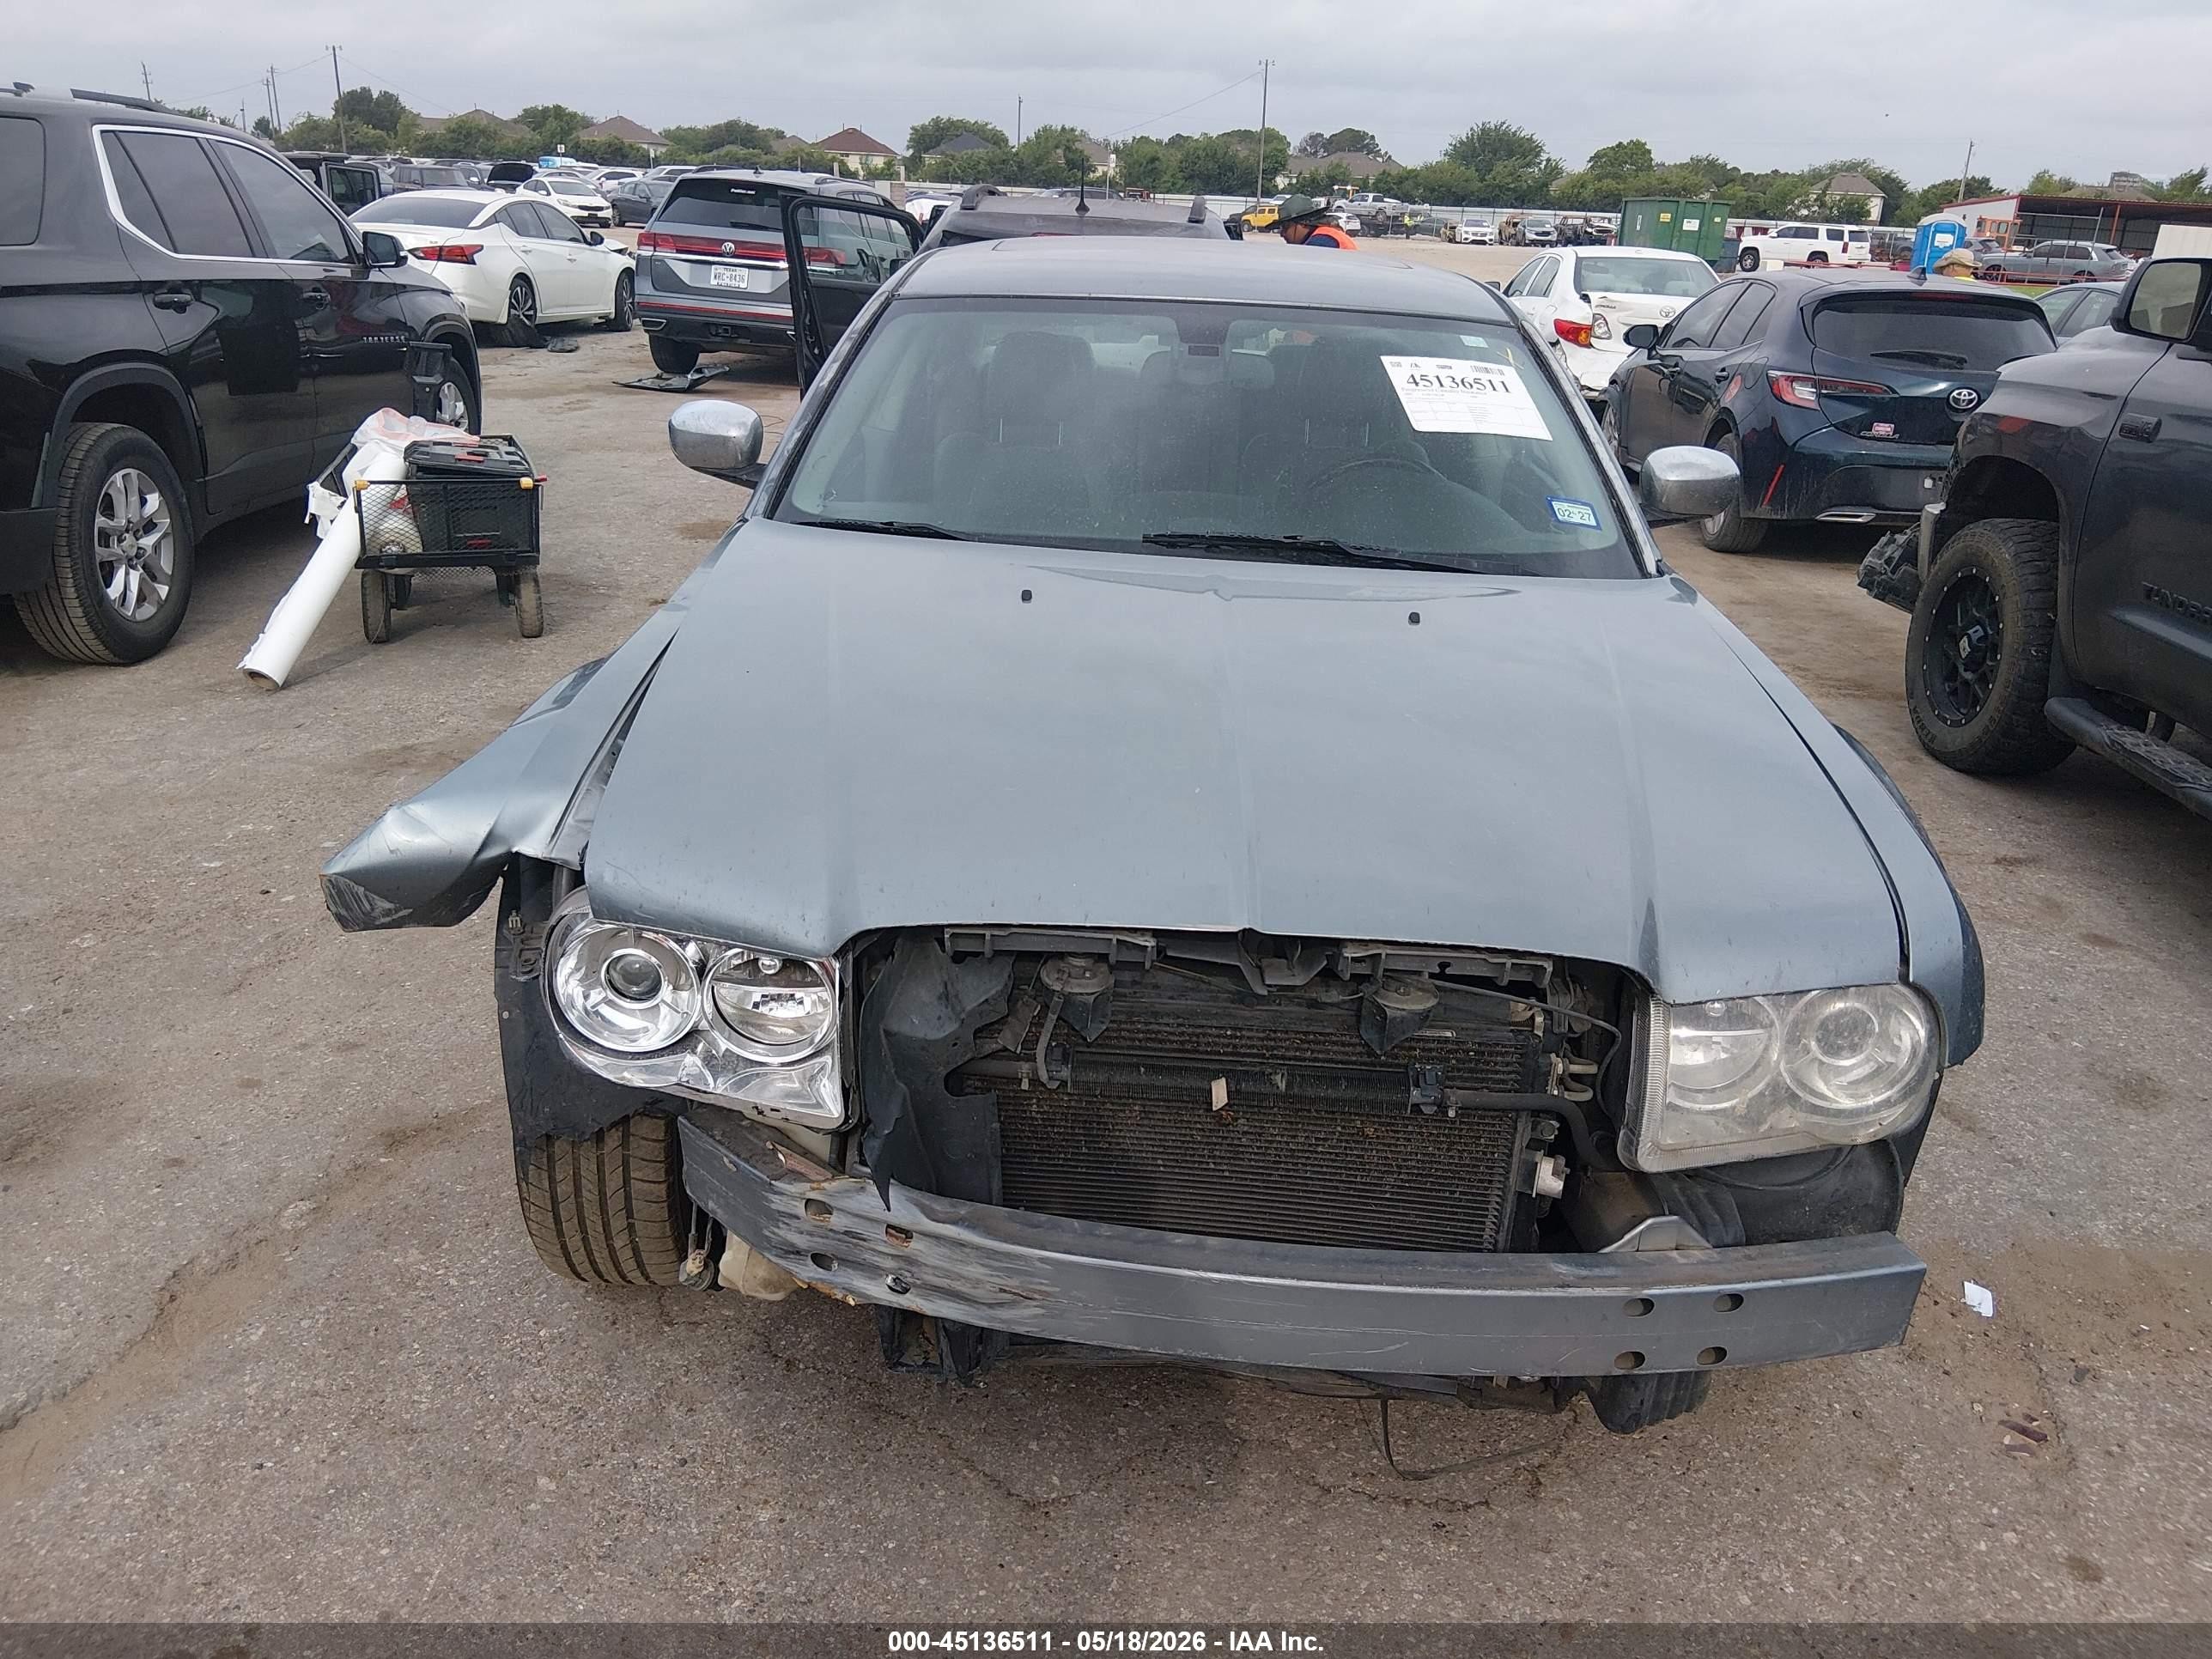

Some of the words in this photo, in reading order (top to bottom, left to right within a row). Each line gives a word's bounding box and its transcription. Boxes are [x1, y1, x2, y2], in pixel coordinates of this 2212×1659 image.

[1407, 374, 1511, 393] 45136511
[1557, 507, 1573, 519] 02
[1577, 510, 1591, 522] 27
